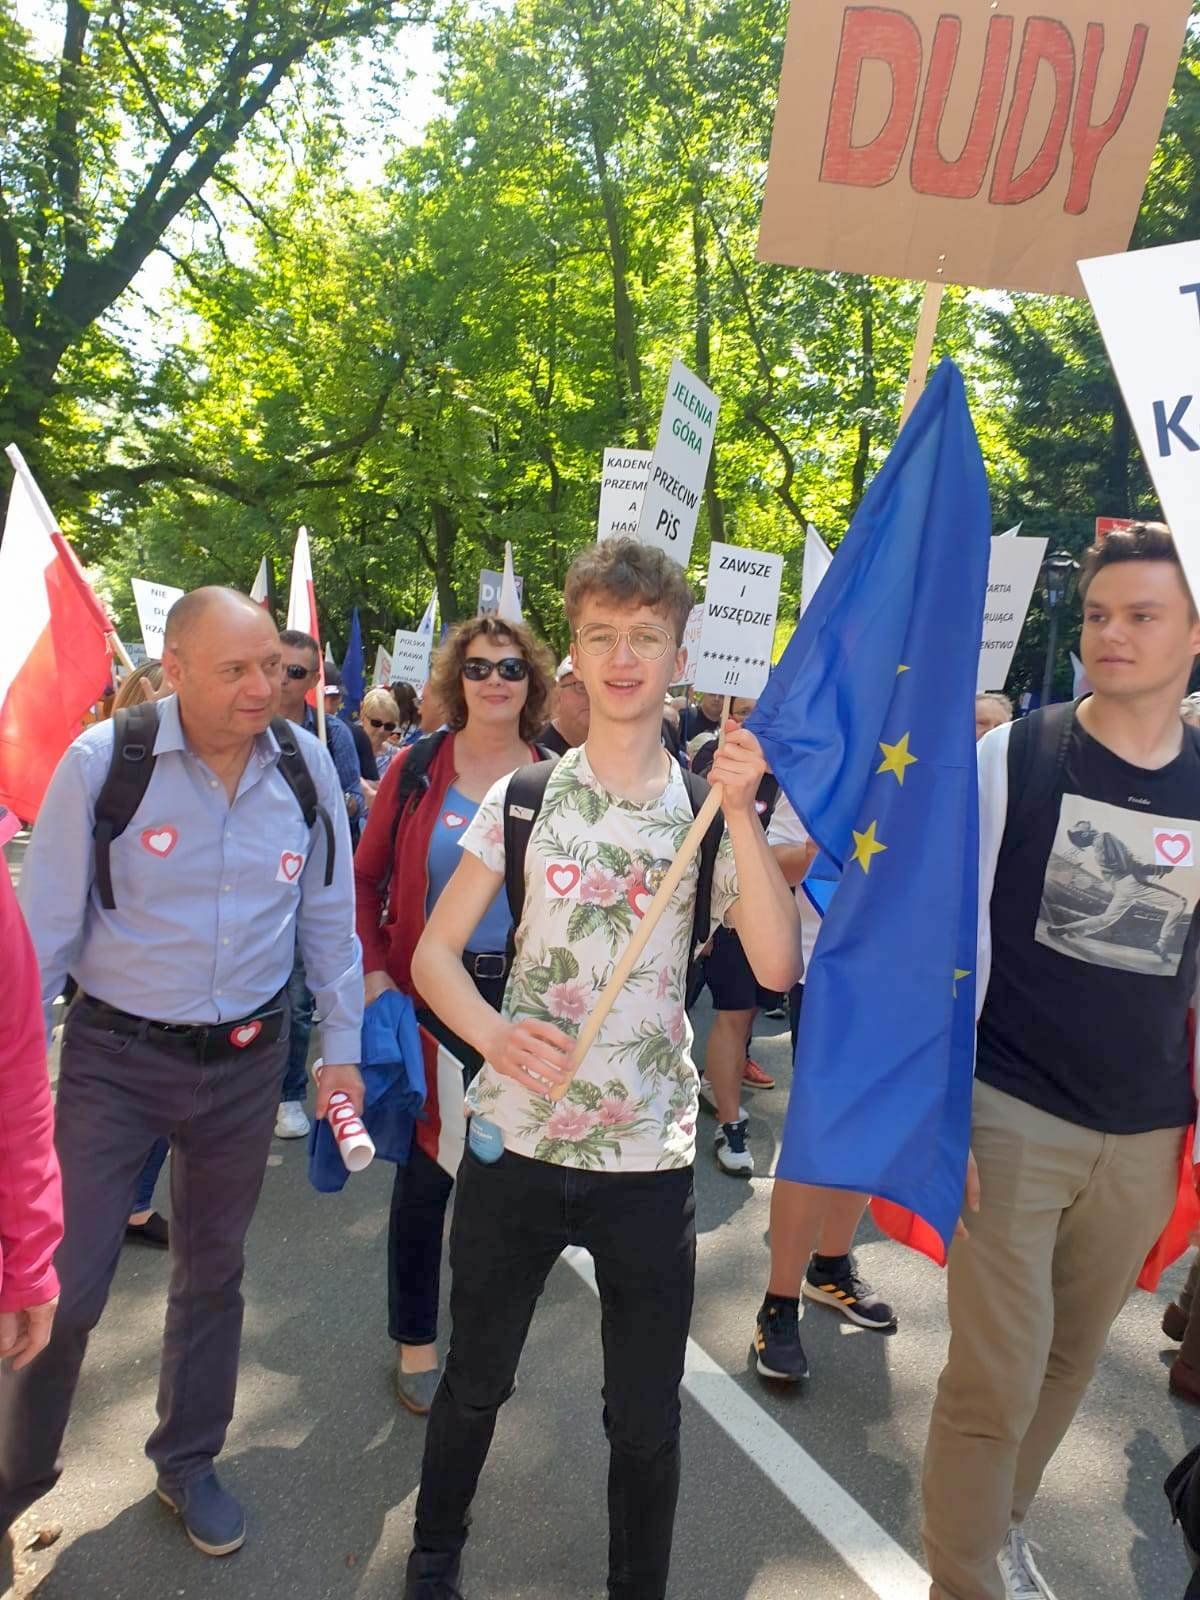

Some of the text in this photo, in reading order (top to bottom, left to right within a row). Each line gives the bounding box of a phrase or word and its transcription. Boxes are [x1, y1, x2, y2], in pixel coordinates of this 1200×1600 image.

[819, 6, 1149, 216] DUDY
[672, 381, 713, 428] JELENIA
[672, 417, 702, 455] GÓRA
[653, 466, 699, 510] PRZECIW
[628, 501, 638, 512] A
[655, 508, 681, 541] PiS
[719, 556, 773, 578] ZAWSZE
[150, 588, 169, 599] NIE
[740, 585, 746, 598] I
[708, 603, 773, 627] WSZĘDZIE
